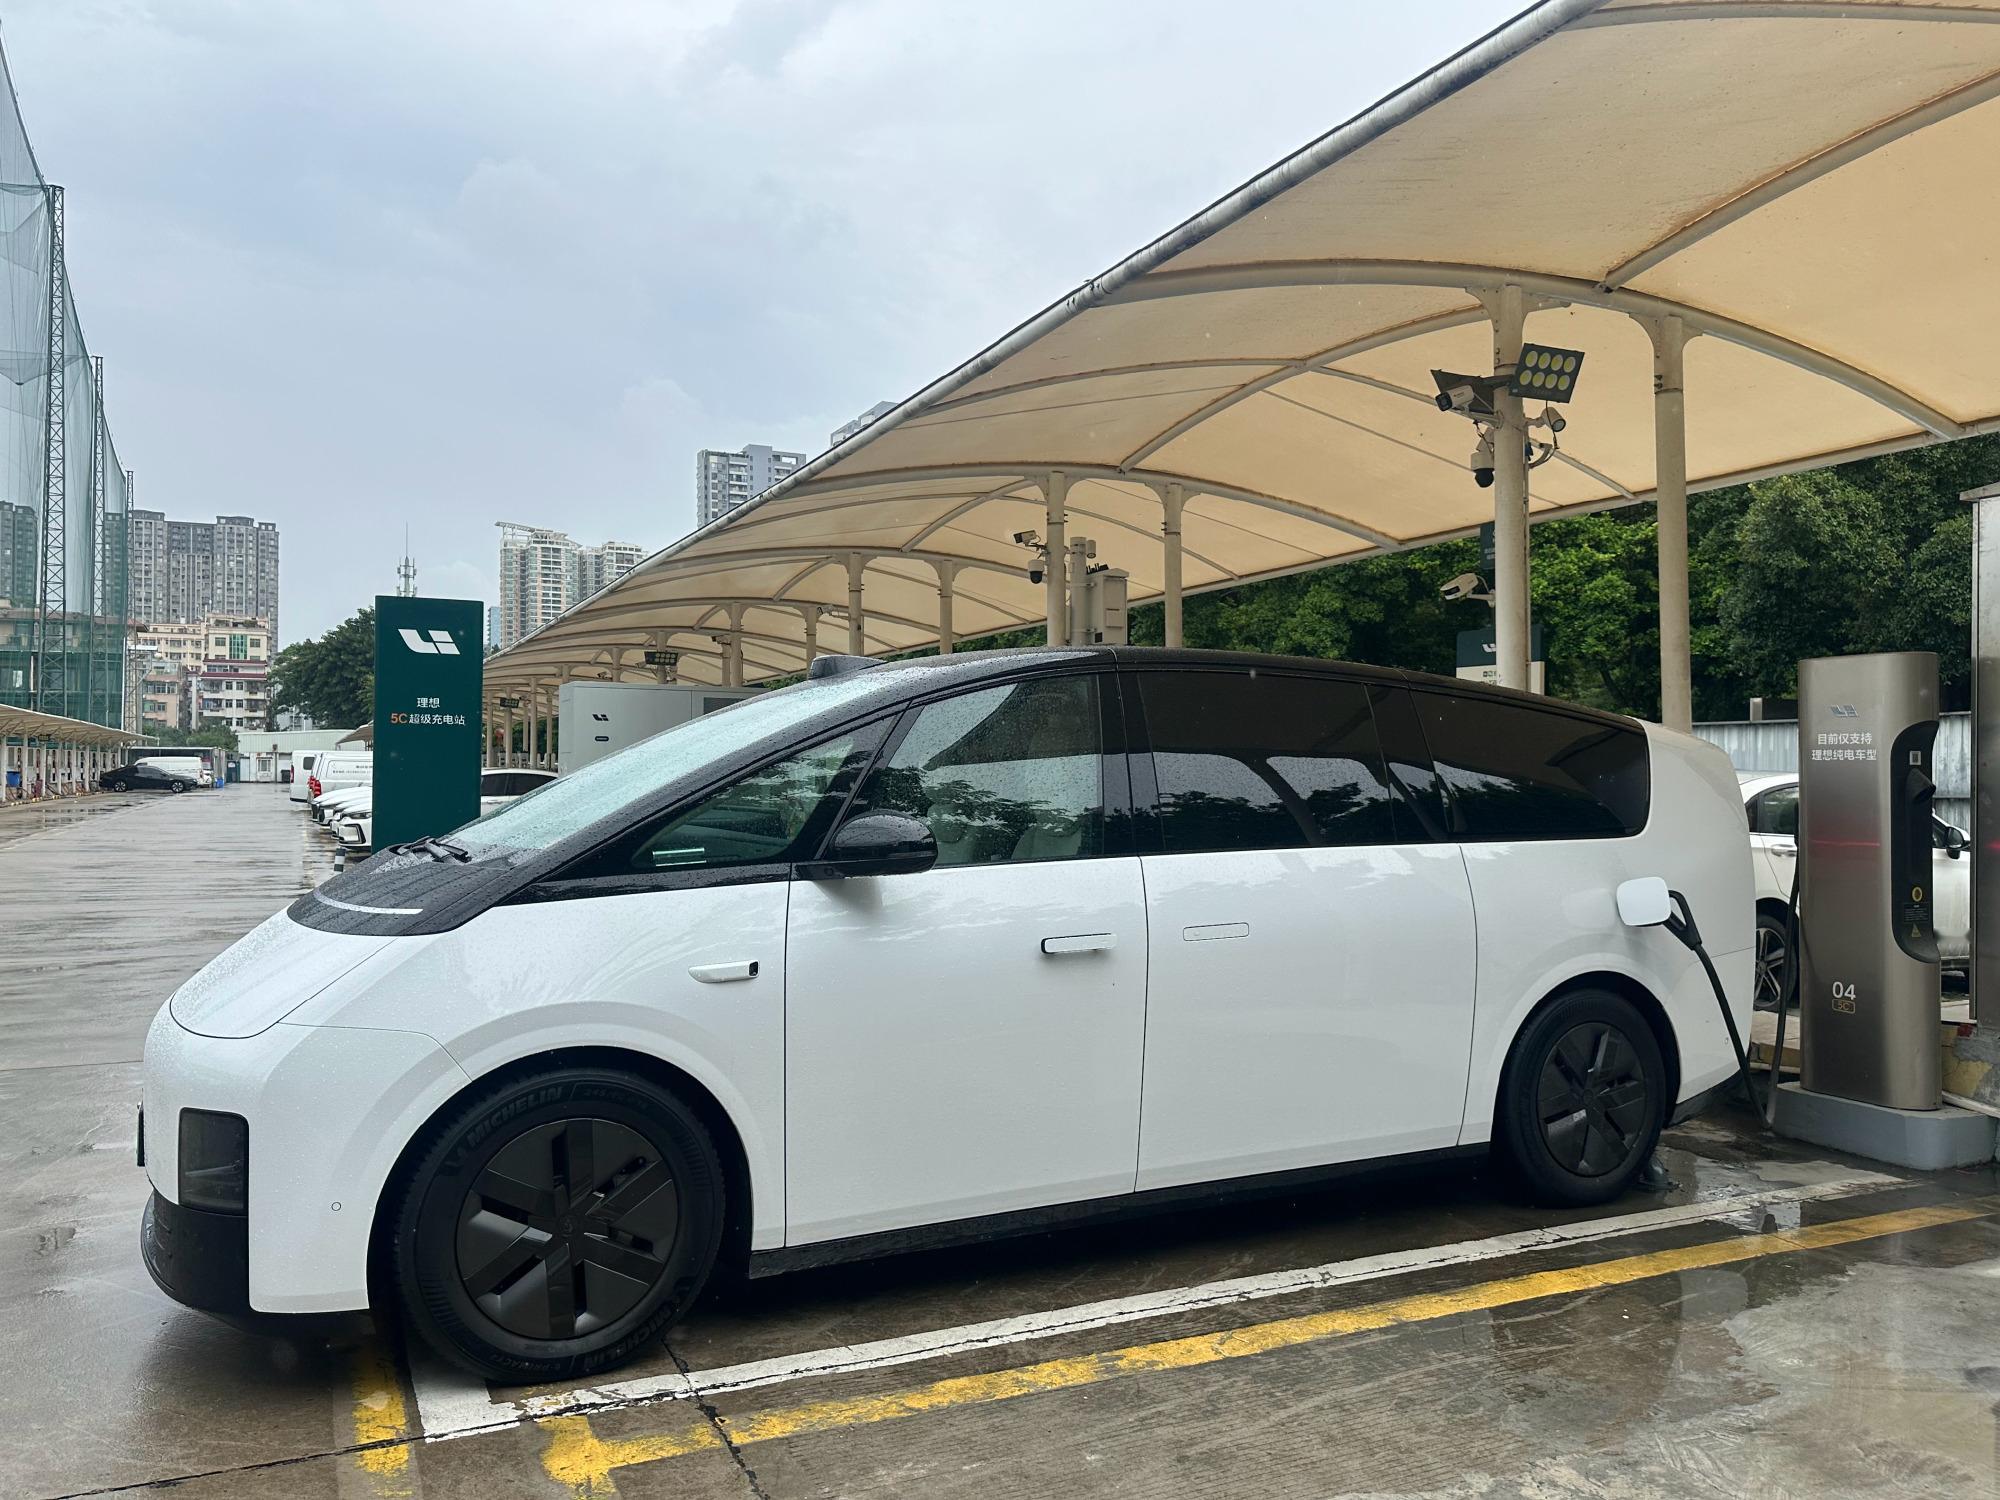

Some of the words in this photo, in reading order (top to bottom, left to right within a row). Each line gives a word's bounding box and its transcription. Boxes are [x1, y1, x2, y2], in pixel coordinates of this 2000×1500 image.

[417, 697, 440, 708] 理想
[1817, 732, 1873, 744] 目前仅支持
[1811, 749, 1877, 761] 理想纯电车型
[1832, 981, 1857, 1000] 04
[466, 1086, 563, 1148] MICHELIN
